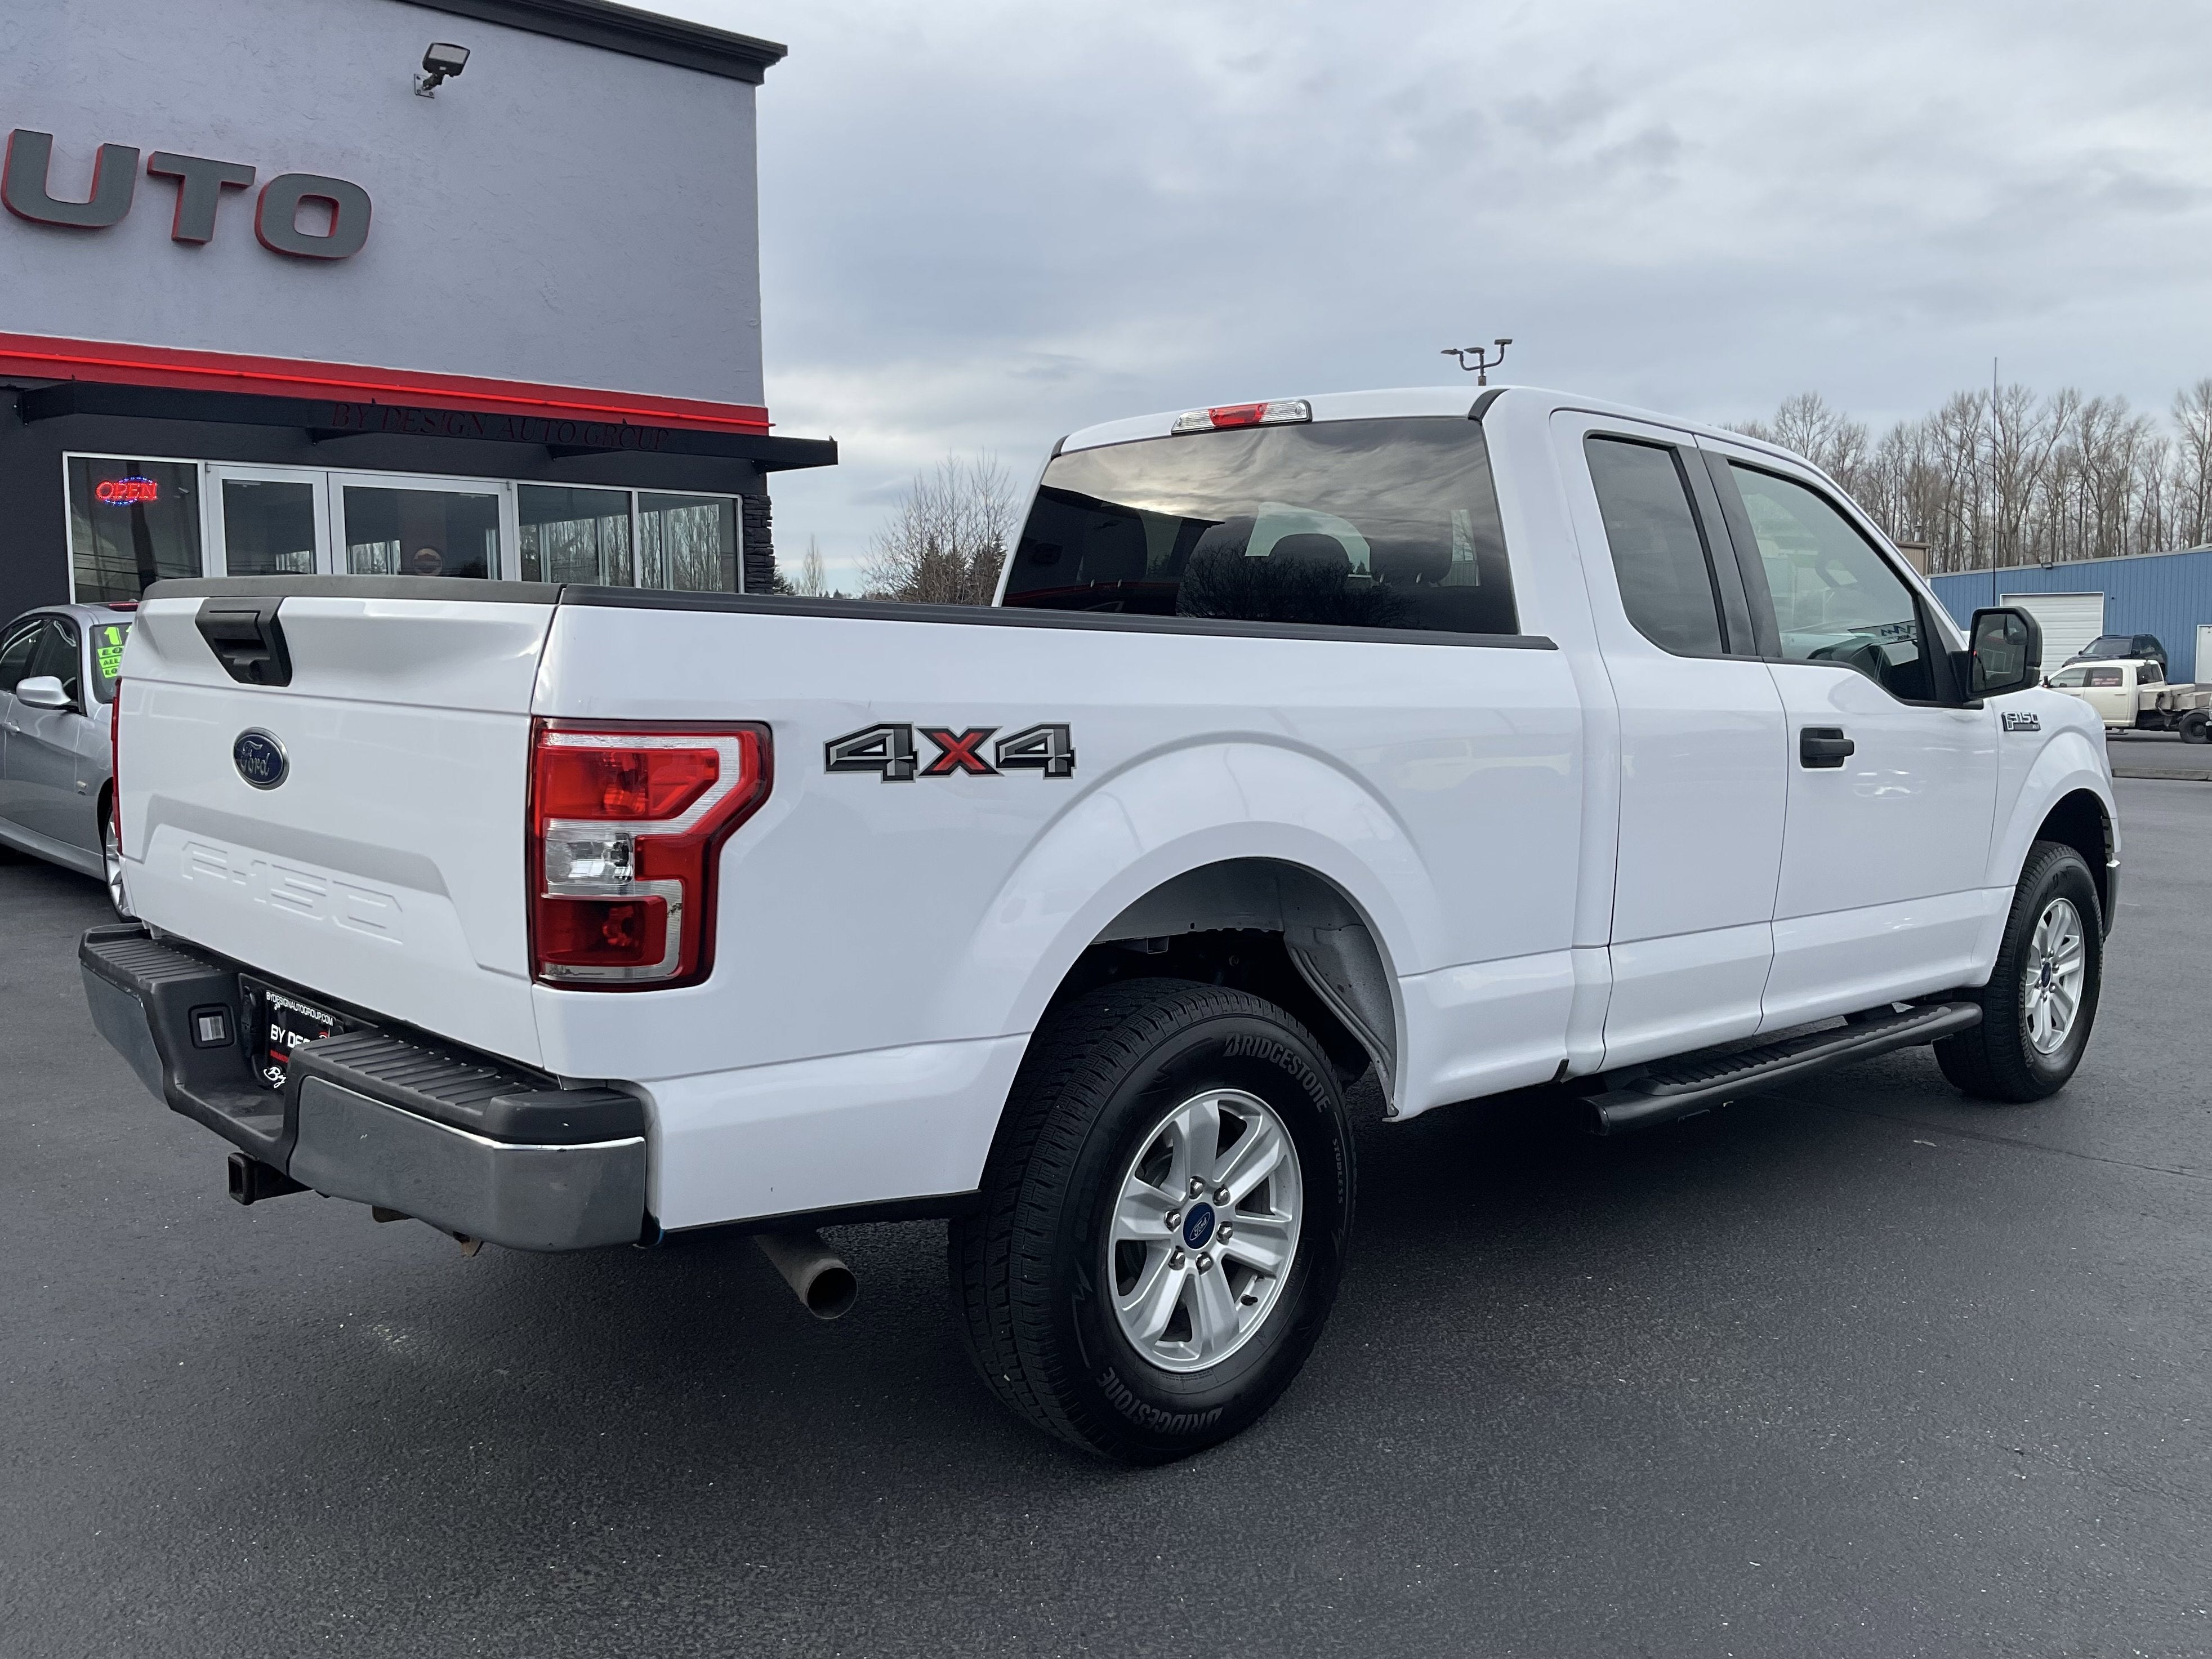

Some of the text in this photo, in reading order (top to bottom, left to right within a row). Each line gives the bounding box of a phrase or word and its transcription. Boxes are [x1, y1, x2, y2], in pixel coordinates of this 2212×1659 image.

[1, 128, 372, 260] UTO
[331, 403, 670, 451] BY DESIGN AUTO GROUP
[95, 480, 158, 501] OPEN
[102, 647, 123, 656] LO
[266, 991, 334, 1027] BYDESIGNAUTOGROUP.COM
[270, 1023, 311, 1049] BY DE
[1223, 1033, 1331, 1113] BRIDGESTONE
[1332, 1138, 1344, 1205] STUDLESS
[1096, 1367, 1224, 1435] BRIDGESTONE
